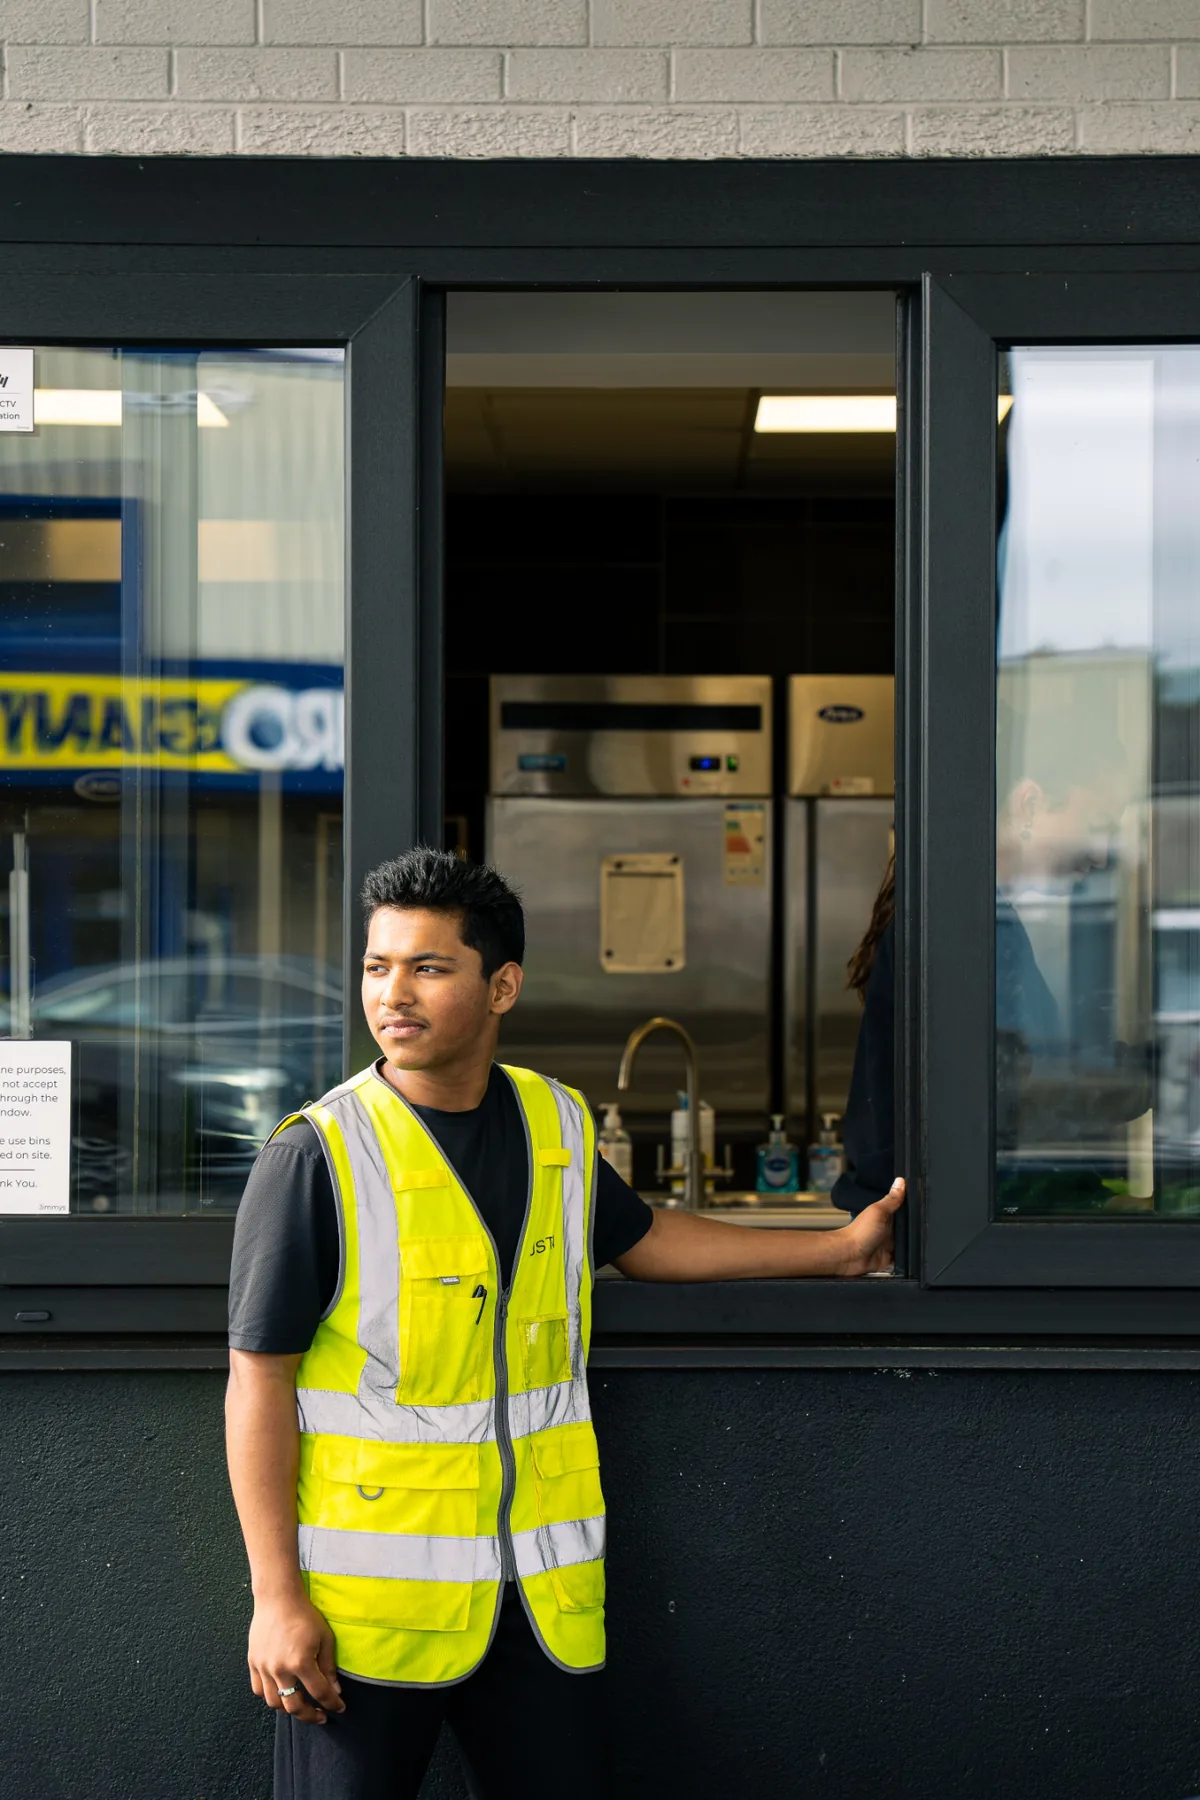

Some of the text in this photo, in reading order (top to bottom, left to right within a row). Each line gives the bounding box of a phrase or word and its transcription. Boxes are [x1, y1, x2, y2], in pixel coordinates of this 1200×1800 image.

[16, 1067, 66, 1075] purposes,
[3, 1080, 58, 1089] not accept
[41, 1093, 58, 1102] the
[0, 1108, 32, 1117] ndow.
[29, 1136, 51, 1145] bins
[16, 1152, 29, 1160] on
[31, 1150, 52, 1160] site.
[16, 1179, 38, 1188] You.
